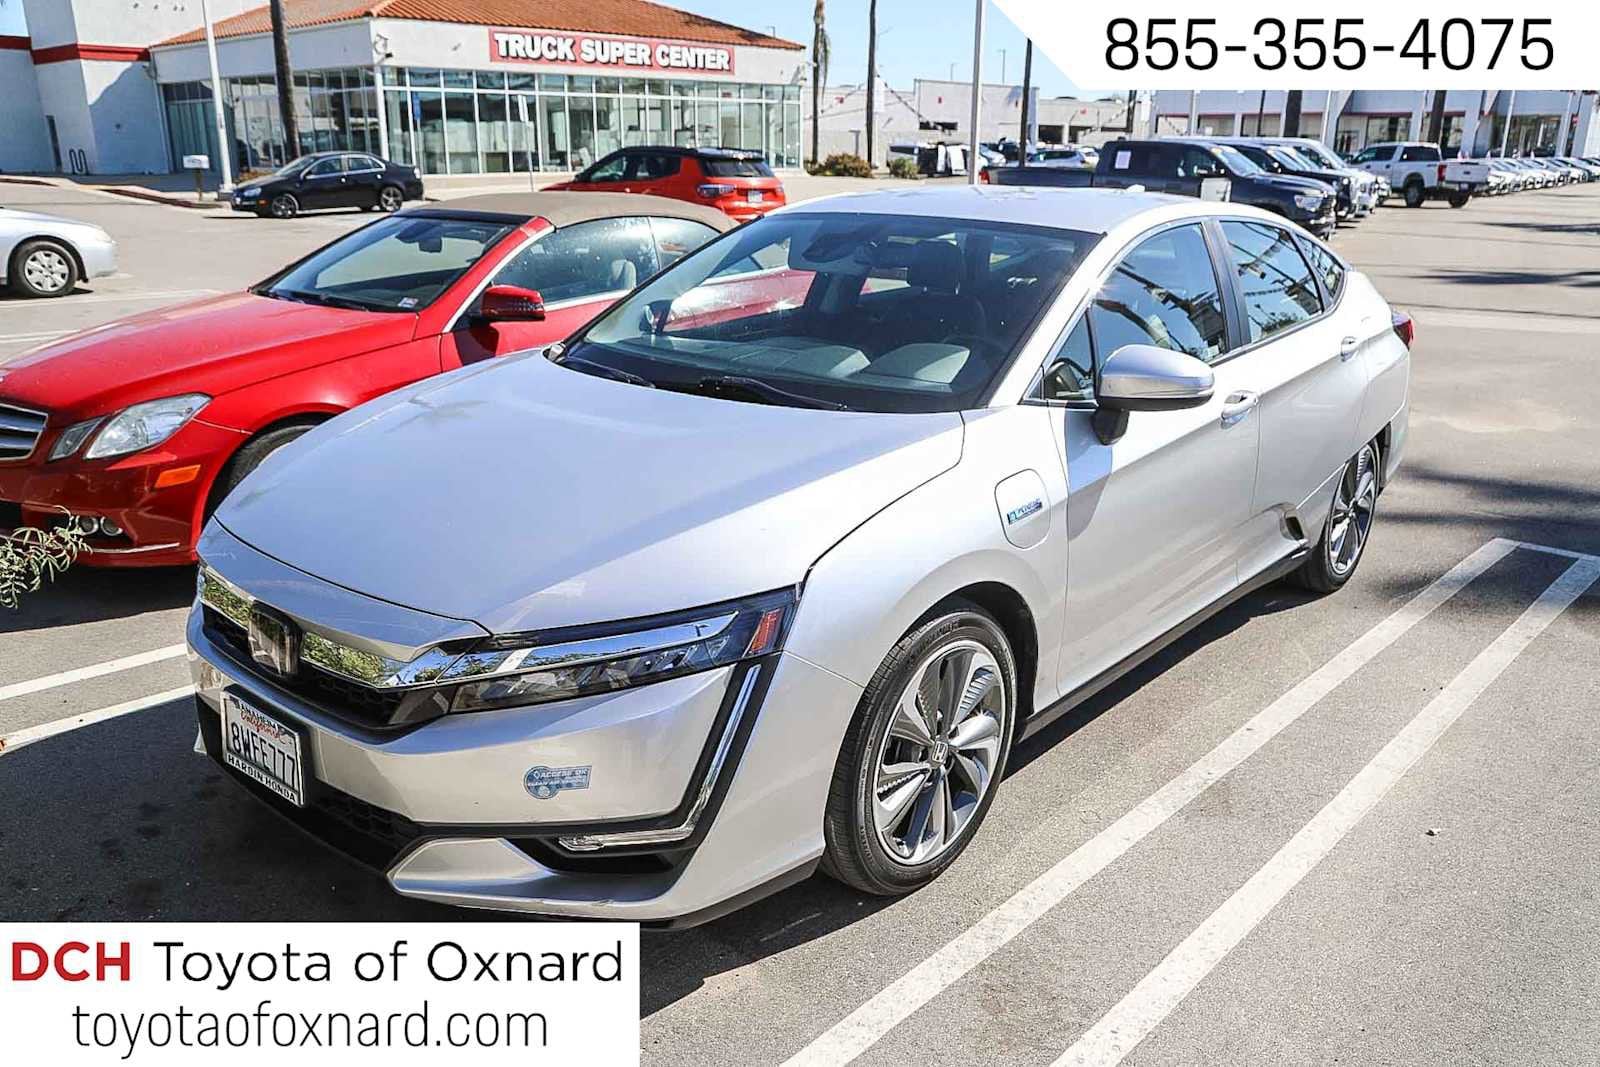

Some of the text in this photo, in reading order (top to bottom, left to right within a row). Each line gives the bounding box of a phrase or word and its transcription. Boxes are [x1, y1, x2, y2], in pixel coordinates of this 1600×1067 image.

[494, 33, 730, 70] TRUCK SUPER CENTER
[227, 753, 297, 803] HARDIN HONDA
[231, 721, 296, 789] 8WFE777
